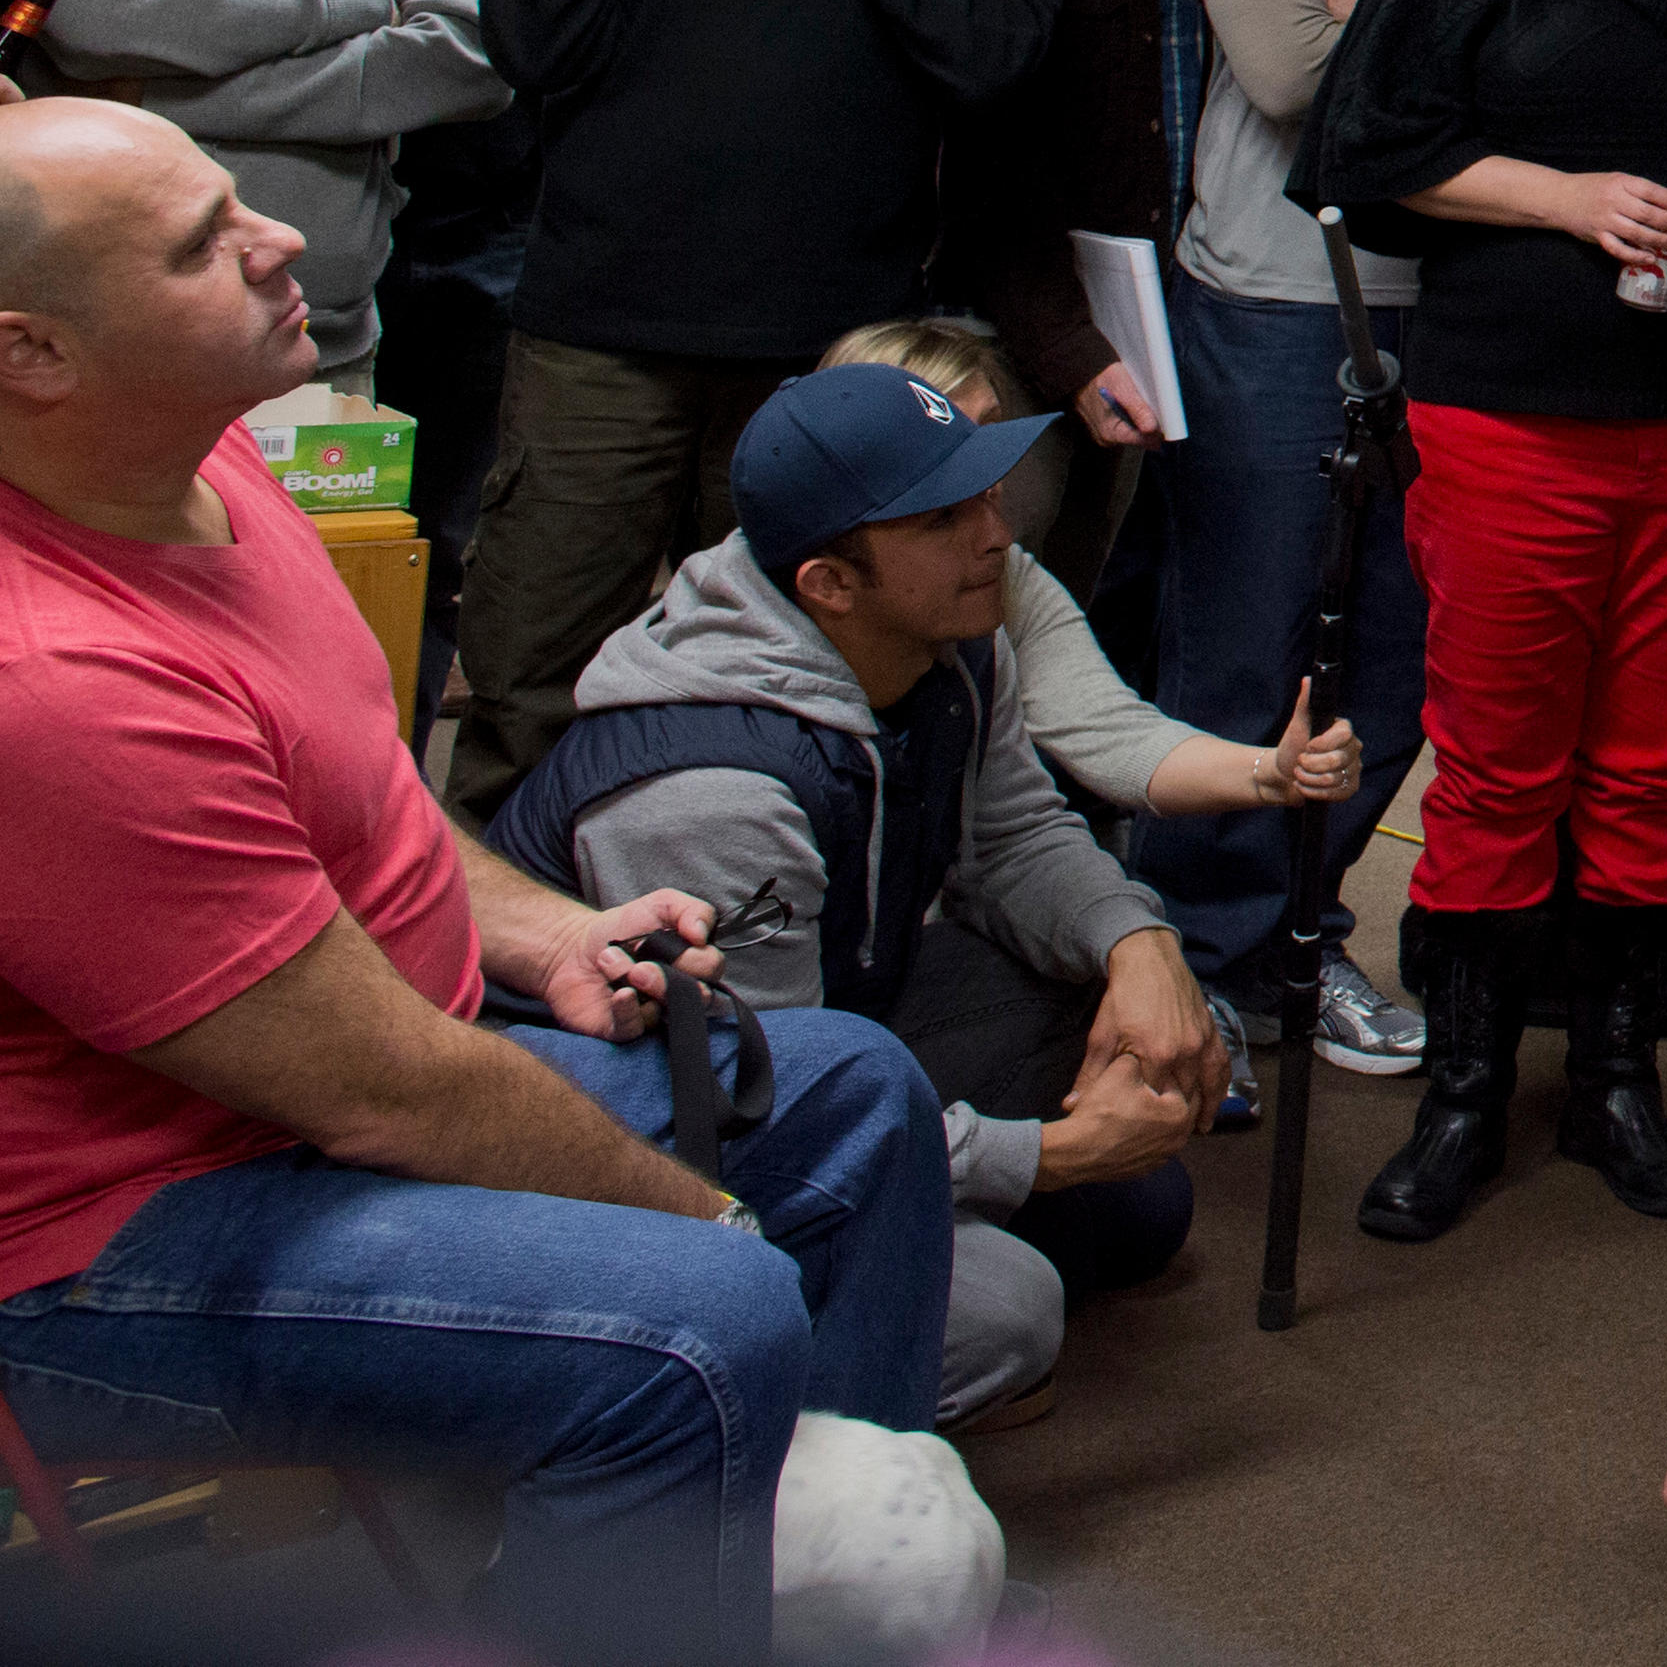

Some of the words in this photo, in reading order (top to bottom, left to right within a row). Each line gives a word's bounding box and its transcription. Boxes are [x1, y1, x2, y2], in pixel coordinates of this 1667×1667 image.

[383, 432, 400, 445] 24
[282, 465, 377, 492] BOOM!
[321, 490, 355, 498] Energy
[357, 487, 375, 496] Gel
